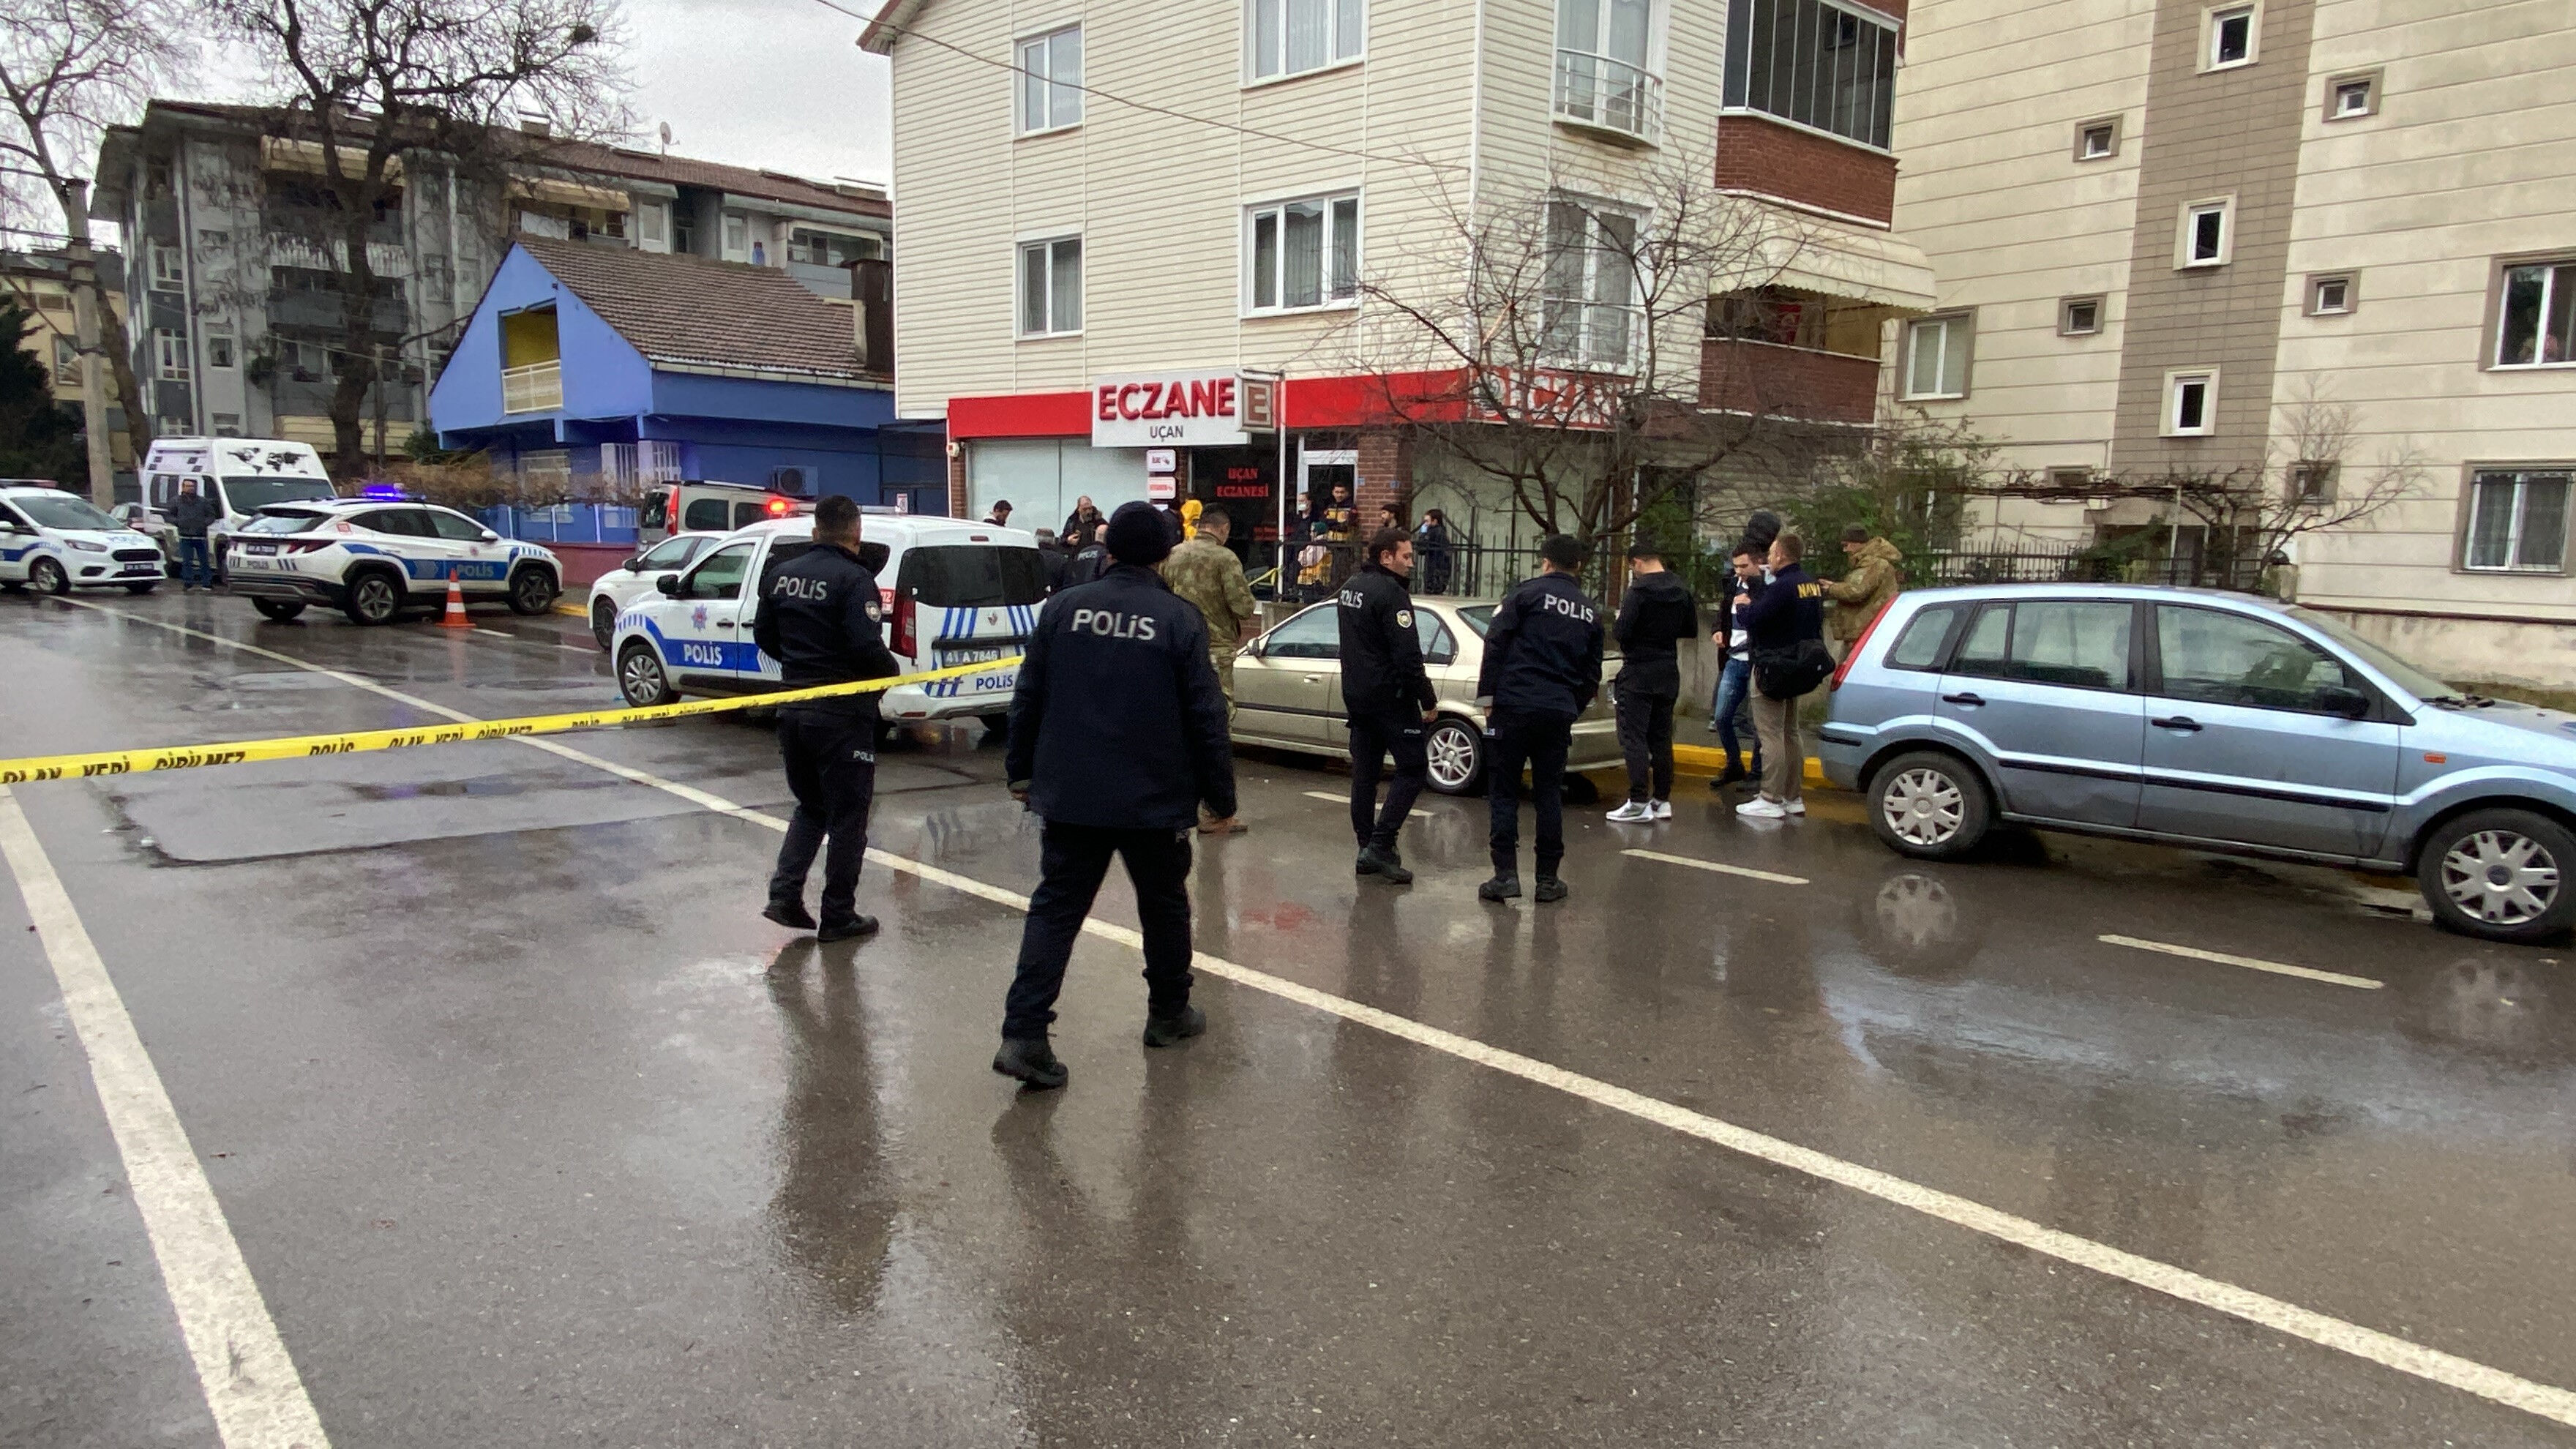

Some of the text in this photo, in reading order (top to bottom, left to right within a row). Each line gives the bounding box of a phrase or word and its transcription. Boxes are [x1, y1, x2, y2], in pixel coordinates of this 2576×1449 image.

[1098, 378, 1235, 421] ECZANE
[1247, 386, 1268, 422] E
[1149, 424, 1184, 442] UÇAN
[683, 640, 723, 667] POLİS
[962, 651, 971, 663] A
[976, 673, 1014, 691] POLİS
